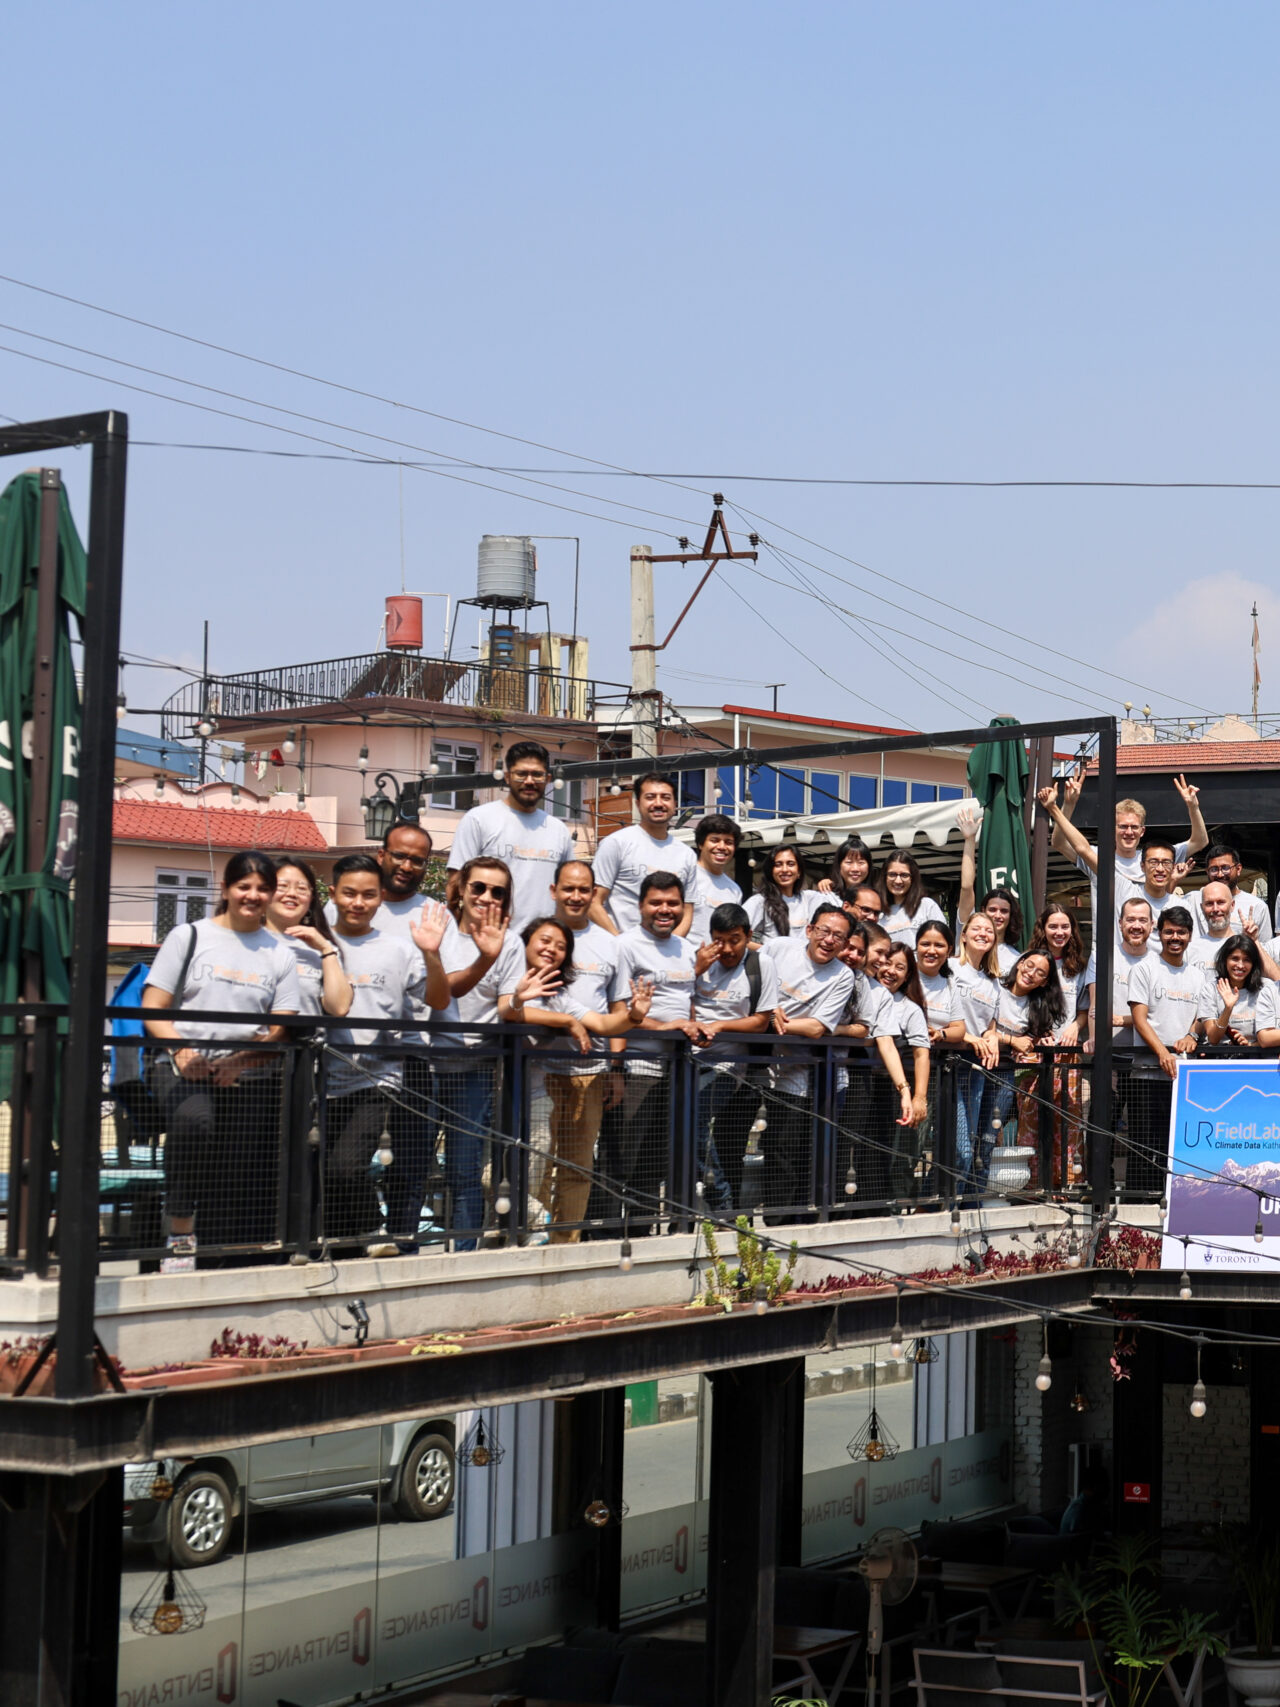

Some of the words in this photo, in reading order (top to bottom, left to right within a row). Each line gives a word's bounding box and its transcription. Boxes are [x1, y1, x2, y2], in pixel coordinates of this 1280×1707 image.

[1184, 1121, 1213, 1148] UR
[1215, 1141, 1243, 1150] Climate
[1244, 1141, 1261, 1150] Data
[1215, 1255, 1260, 1264] TORONTO
